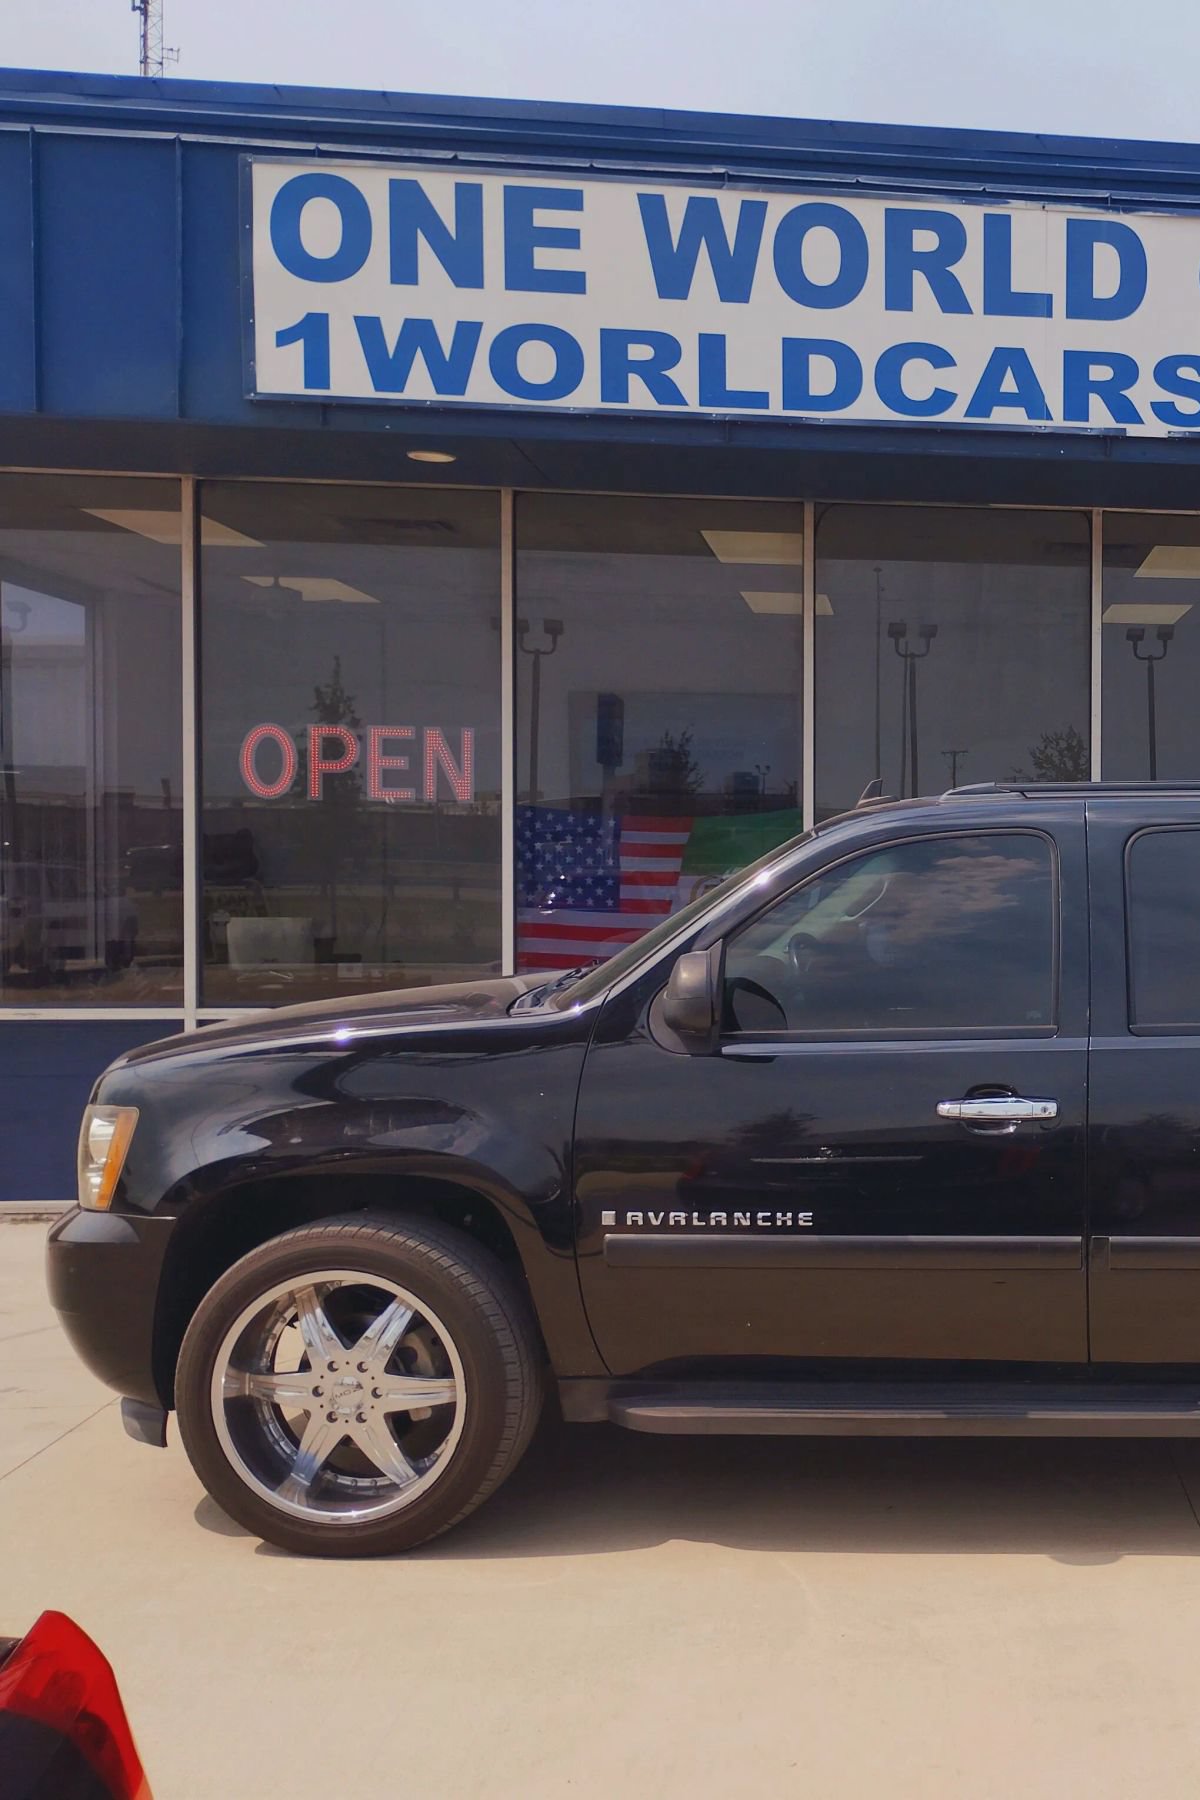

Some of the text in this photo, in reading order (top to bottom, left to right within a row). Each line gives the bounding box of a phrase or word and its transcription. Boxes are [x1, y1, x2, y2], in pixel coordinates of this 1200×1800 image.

[269, 172, 587, 294] ONE
[637, 193, 1148, 321] WORLD
[239, 723, 475, 802] OPEN
[626, 1211, 814, 1226] AVALANCHE
